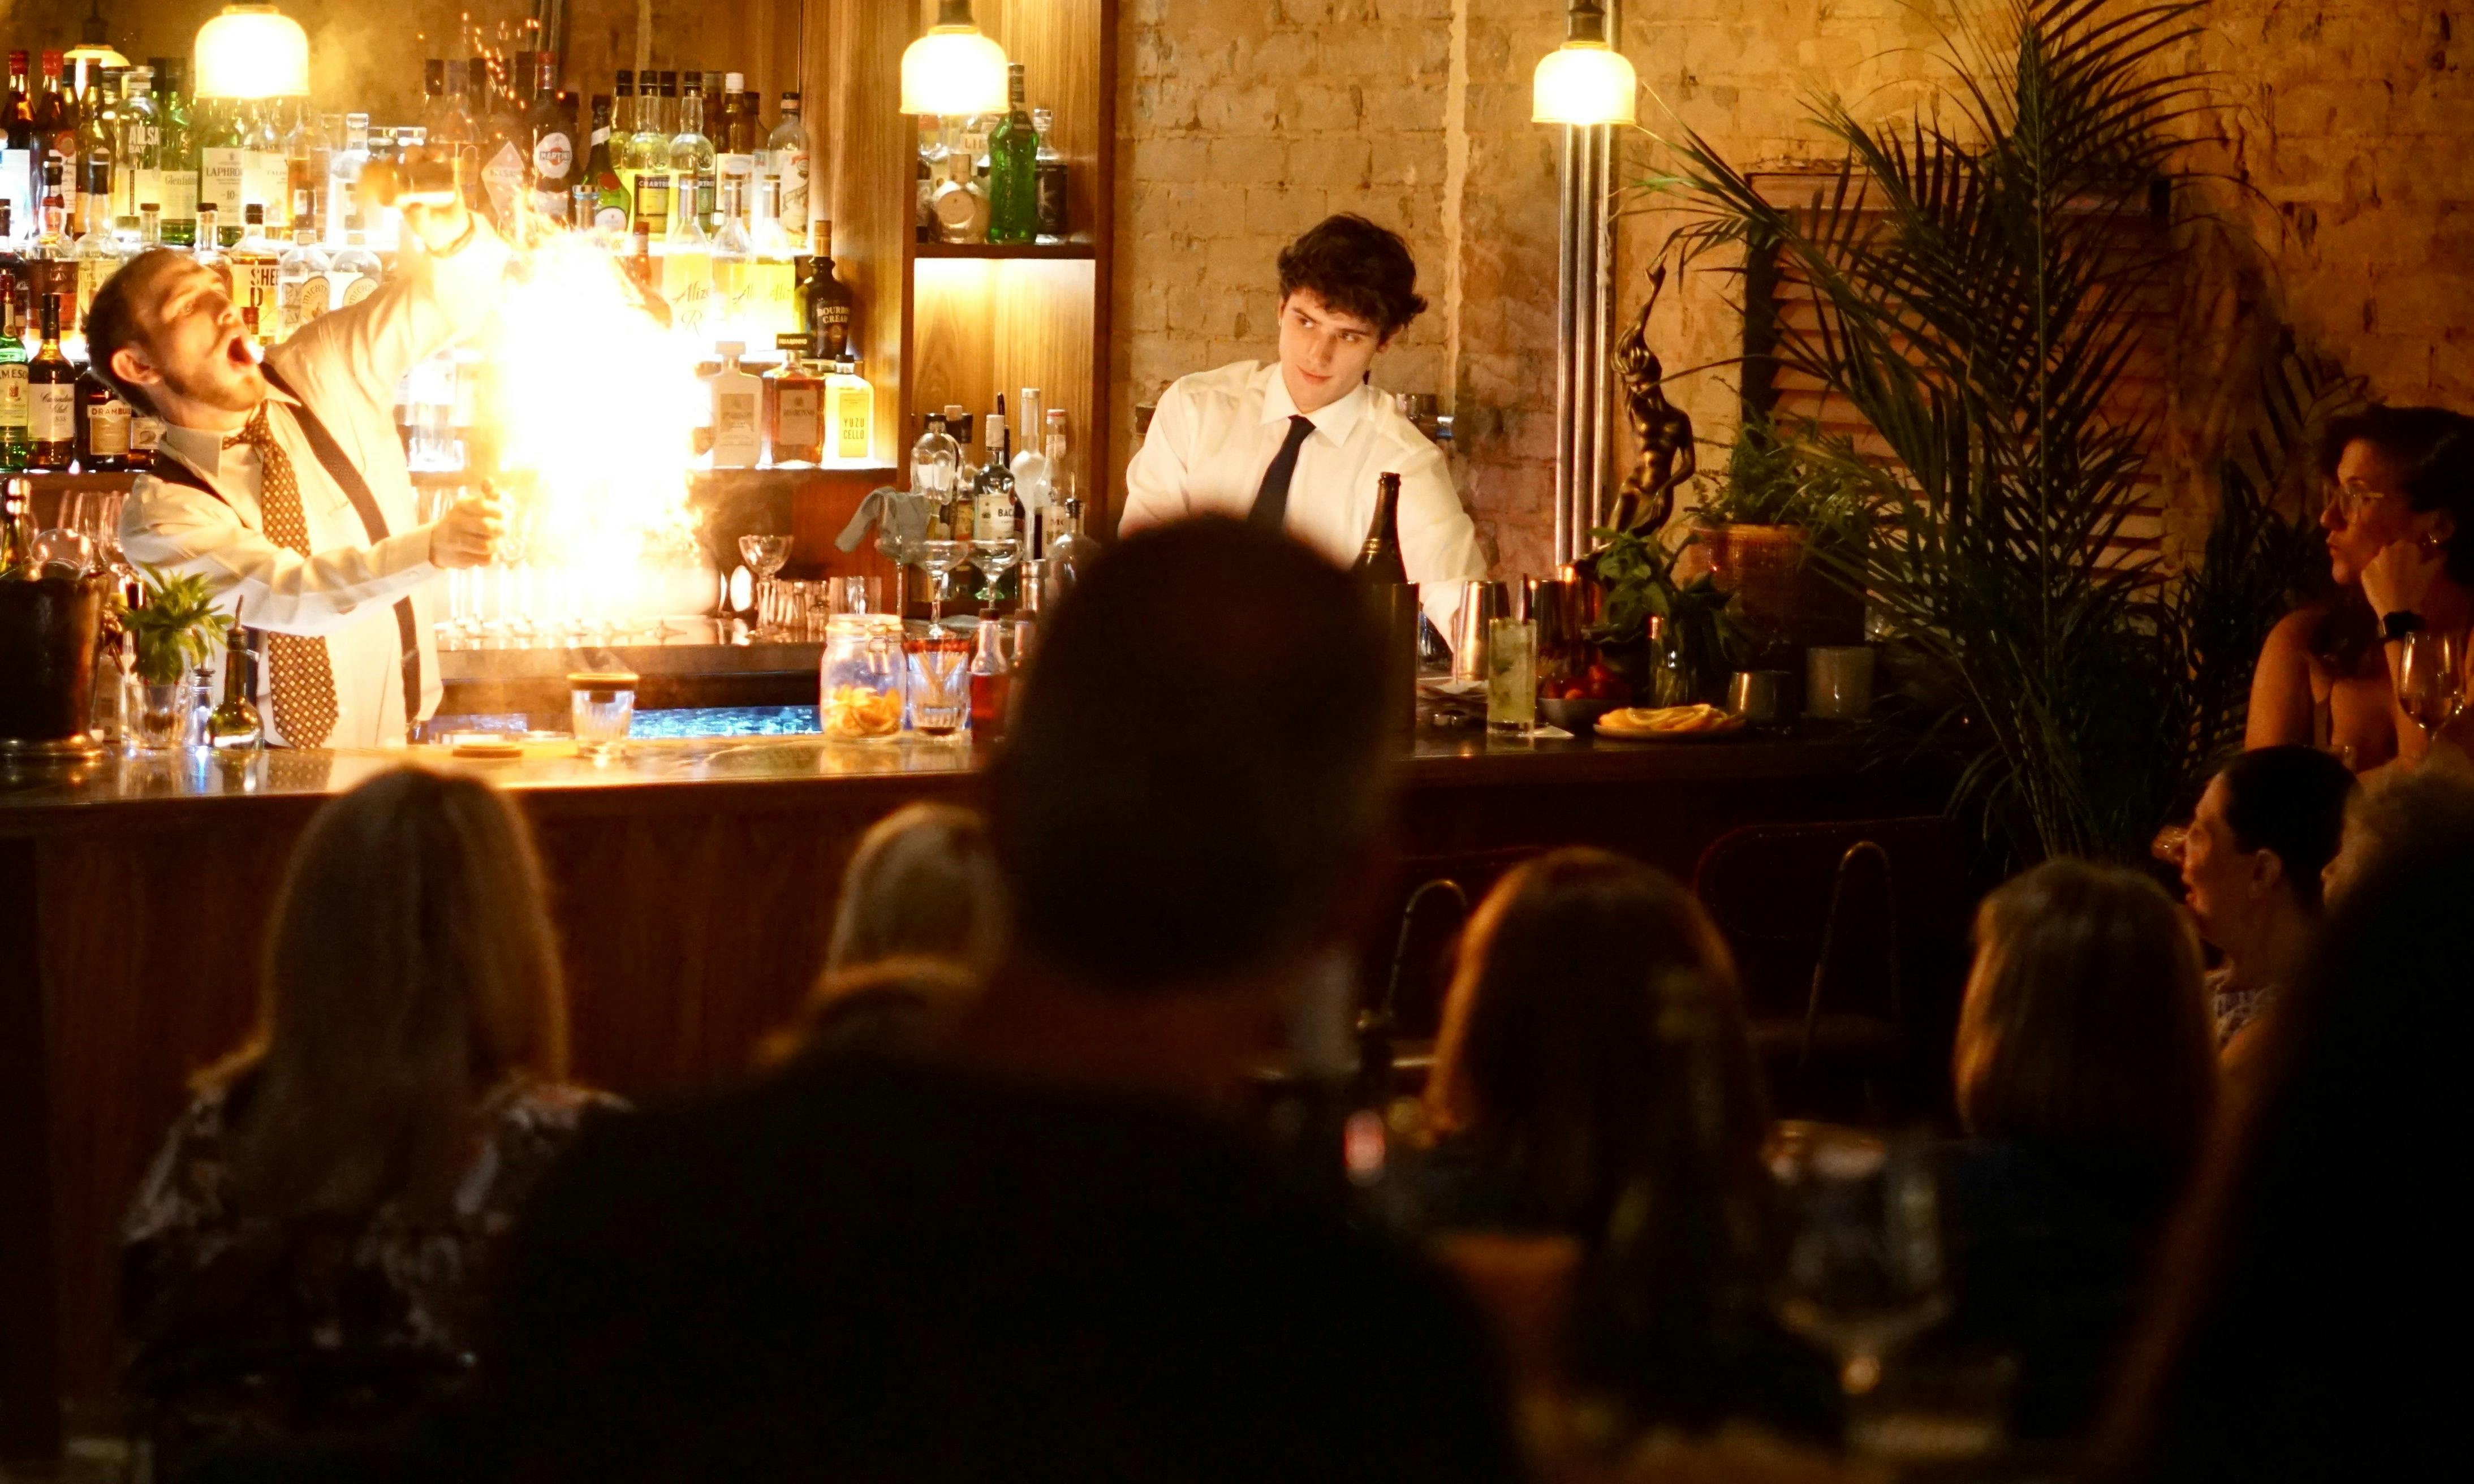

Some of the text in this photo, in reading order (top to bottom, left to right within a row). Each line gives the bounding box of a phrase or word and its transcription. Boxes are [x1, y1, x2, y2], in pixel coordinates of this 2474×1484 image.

[227, 190, 235, 200] 10
[843, 417, 864, 428] YUZU
[843, 429, 864, 439] CELLO
